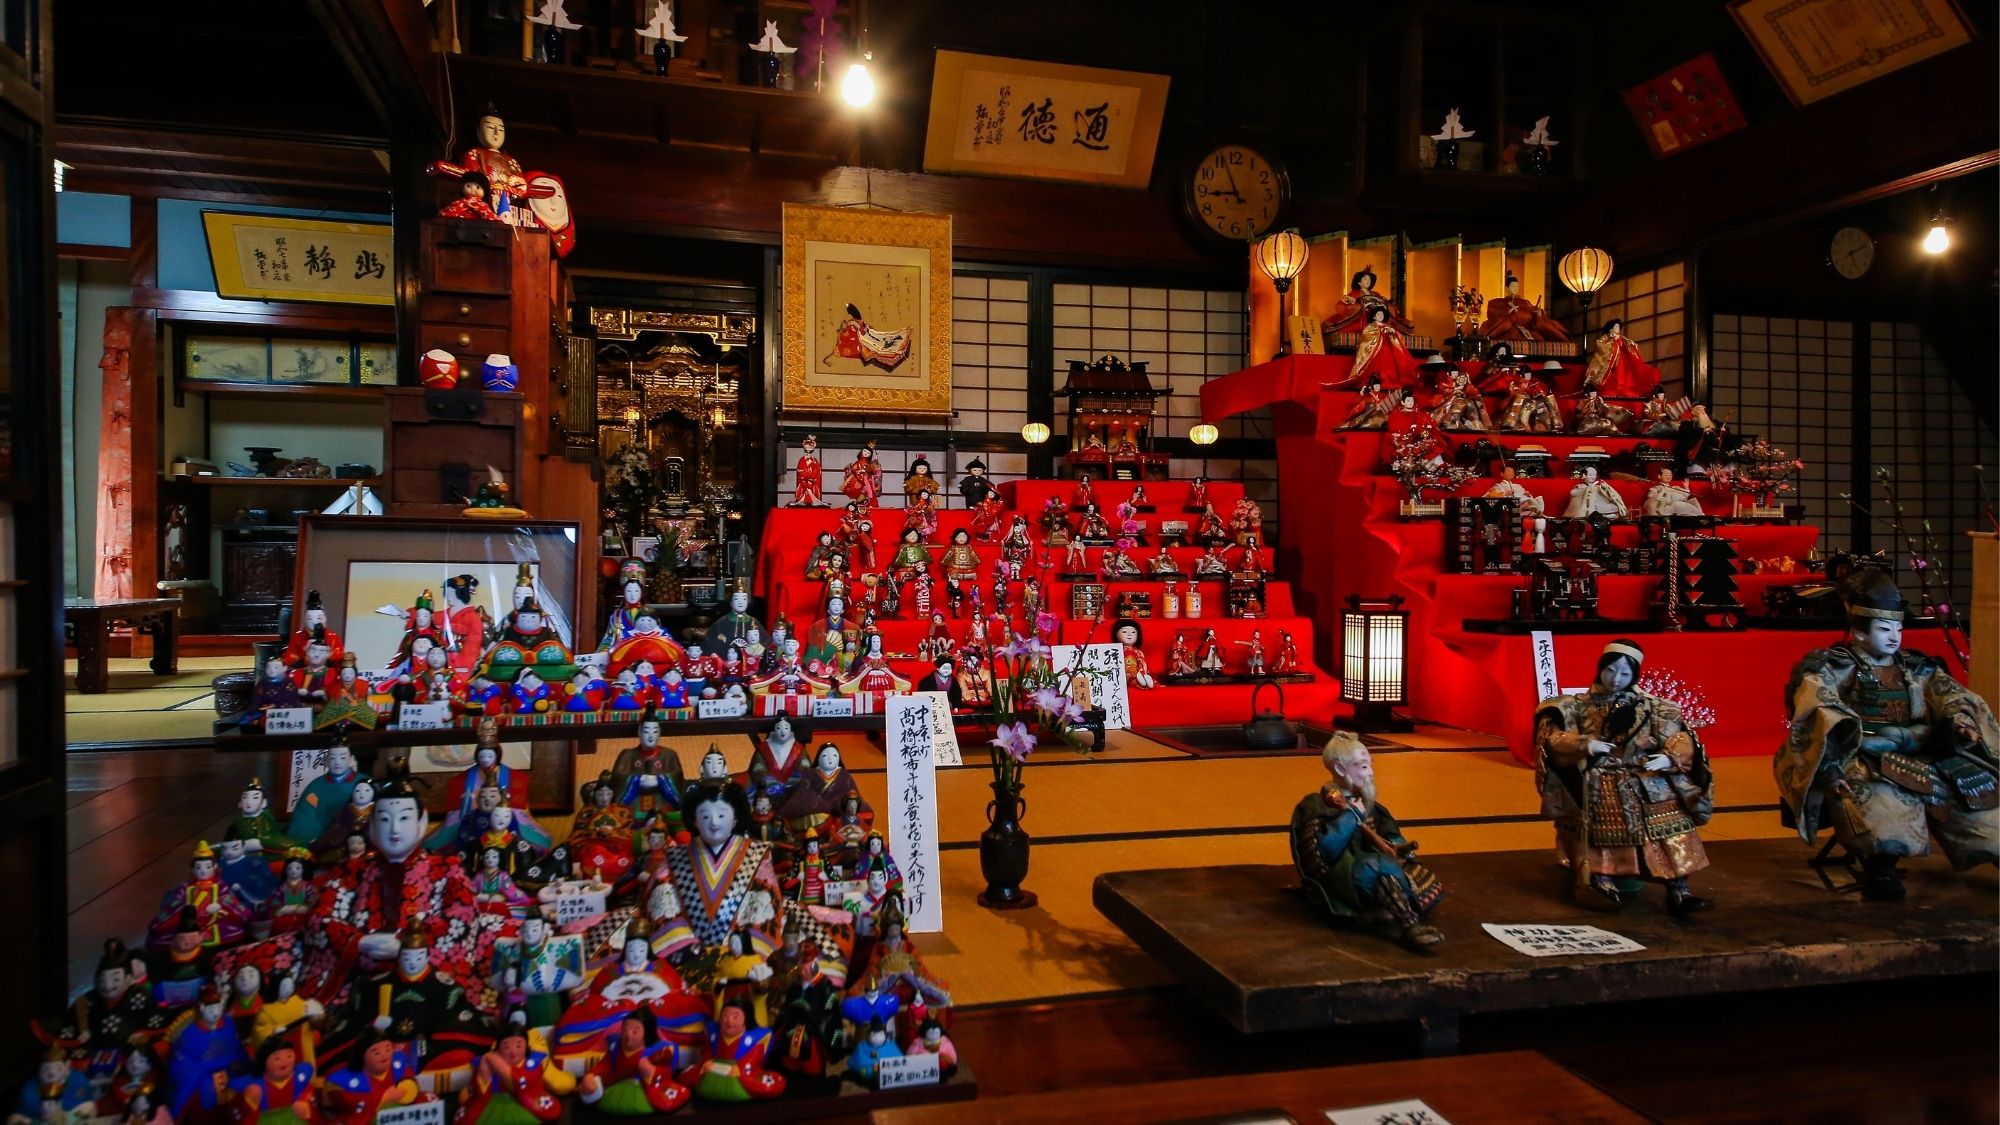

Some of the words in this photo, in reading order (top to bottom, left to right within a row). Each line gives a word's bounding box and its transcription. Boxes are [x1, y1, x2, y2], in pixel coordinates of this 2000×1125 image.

[1230, 152, 1242, 164] 12
[1202, 168, 1214, 180] 10
[1260, 171, 1268, 184] 2
[1198, 184, 1208, 197] 9
[1264, 189, 1273, 202] 3
[1202, 203, 1212, 216] 8
[1217, 216, 1226, 229] 7
[1231, 222, 1240, 235] 6
